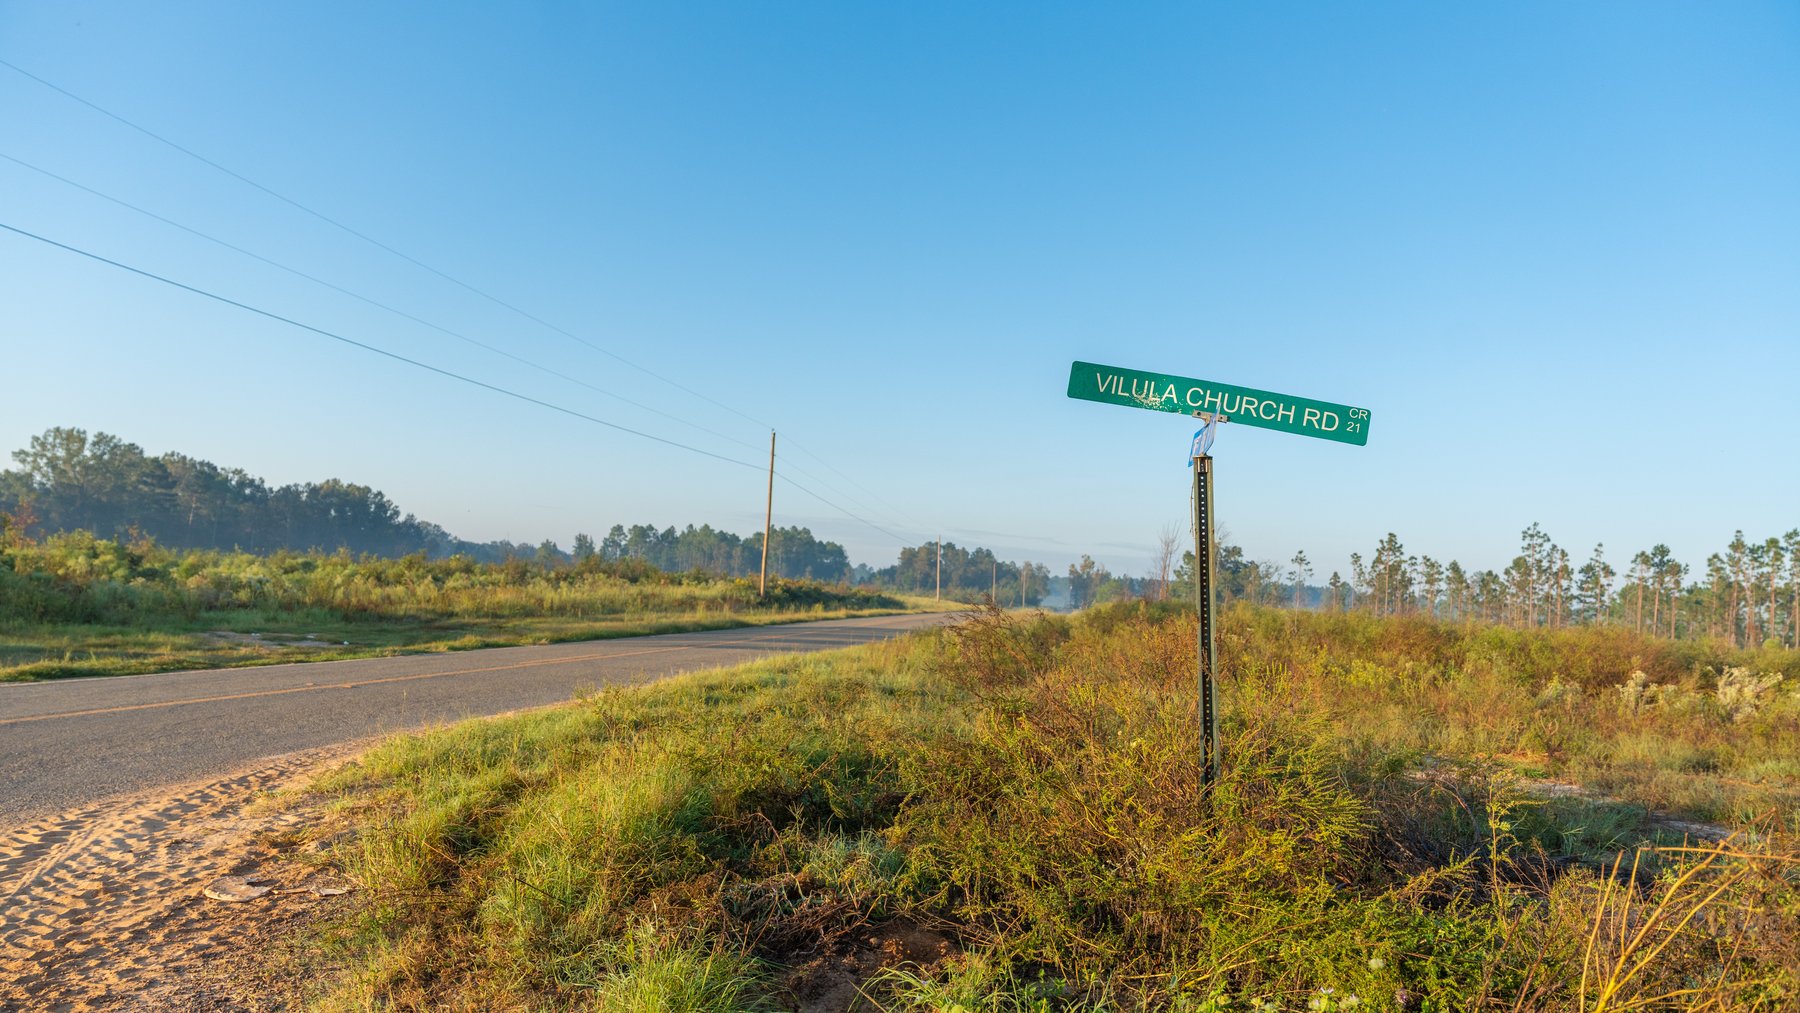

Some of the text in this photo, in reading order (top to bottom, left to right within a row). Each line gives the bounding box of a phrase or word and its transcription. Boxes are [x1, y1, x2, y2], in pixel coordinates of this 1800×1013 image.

[1096, 373, 1339, 433] VILULA CHURCH RD
[1349, 408, 1368, 421] CR
[1346, 421, 1361, 433] 21
